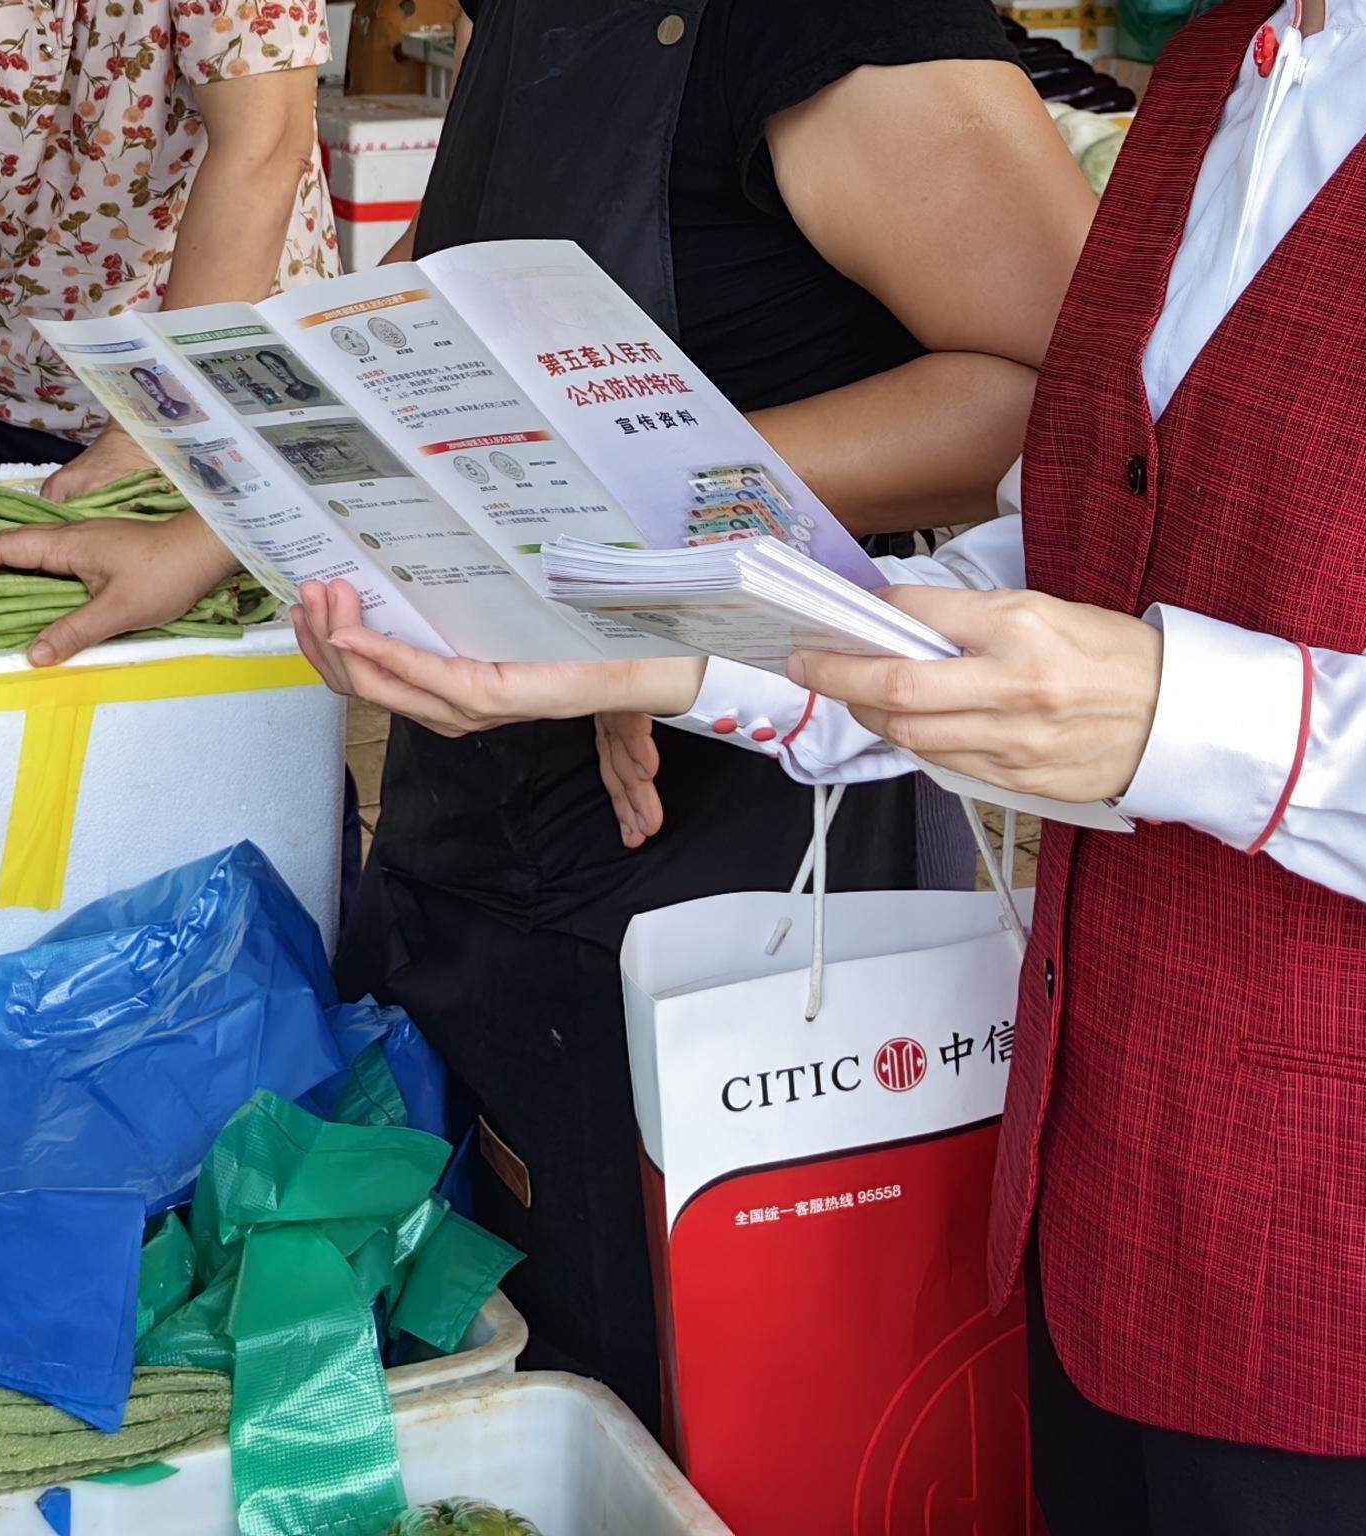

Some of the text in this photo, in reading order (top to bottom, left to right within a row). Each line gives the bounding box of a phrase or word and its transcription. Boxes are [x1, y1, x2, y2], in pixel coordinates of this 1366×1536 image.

[536, 340, 664, 378] 第五套人民币
[565, 372, 695, 408] 公众防伪特征
[614, 408, 701, 435] 宣传资料
[721, 1020, 1016, 1113] CITIC 中信
[734, 1183, 902, 1227] 全国统一客服热线 95558
